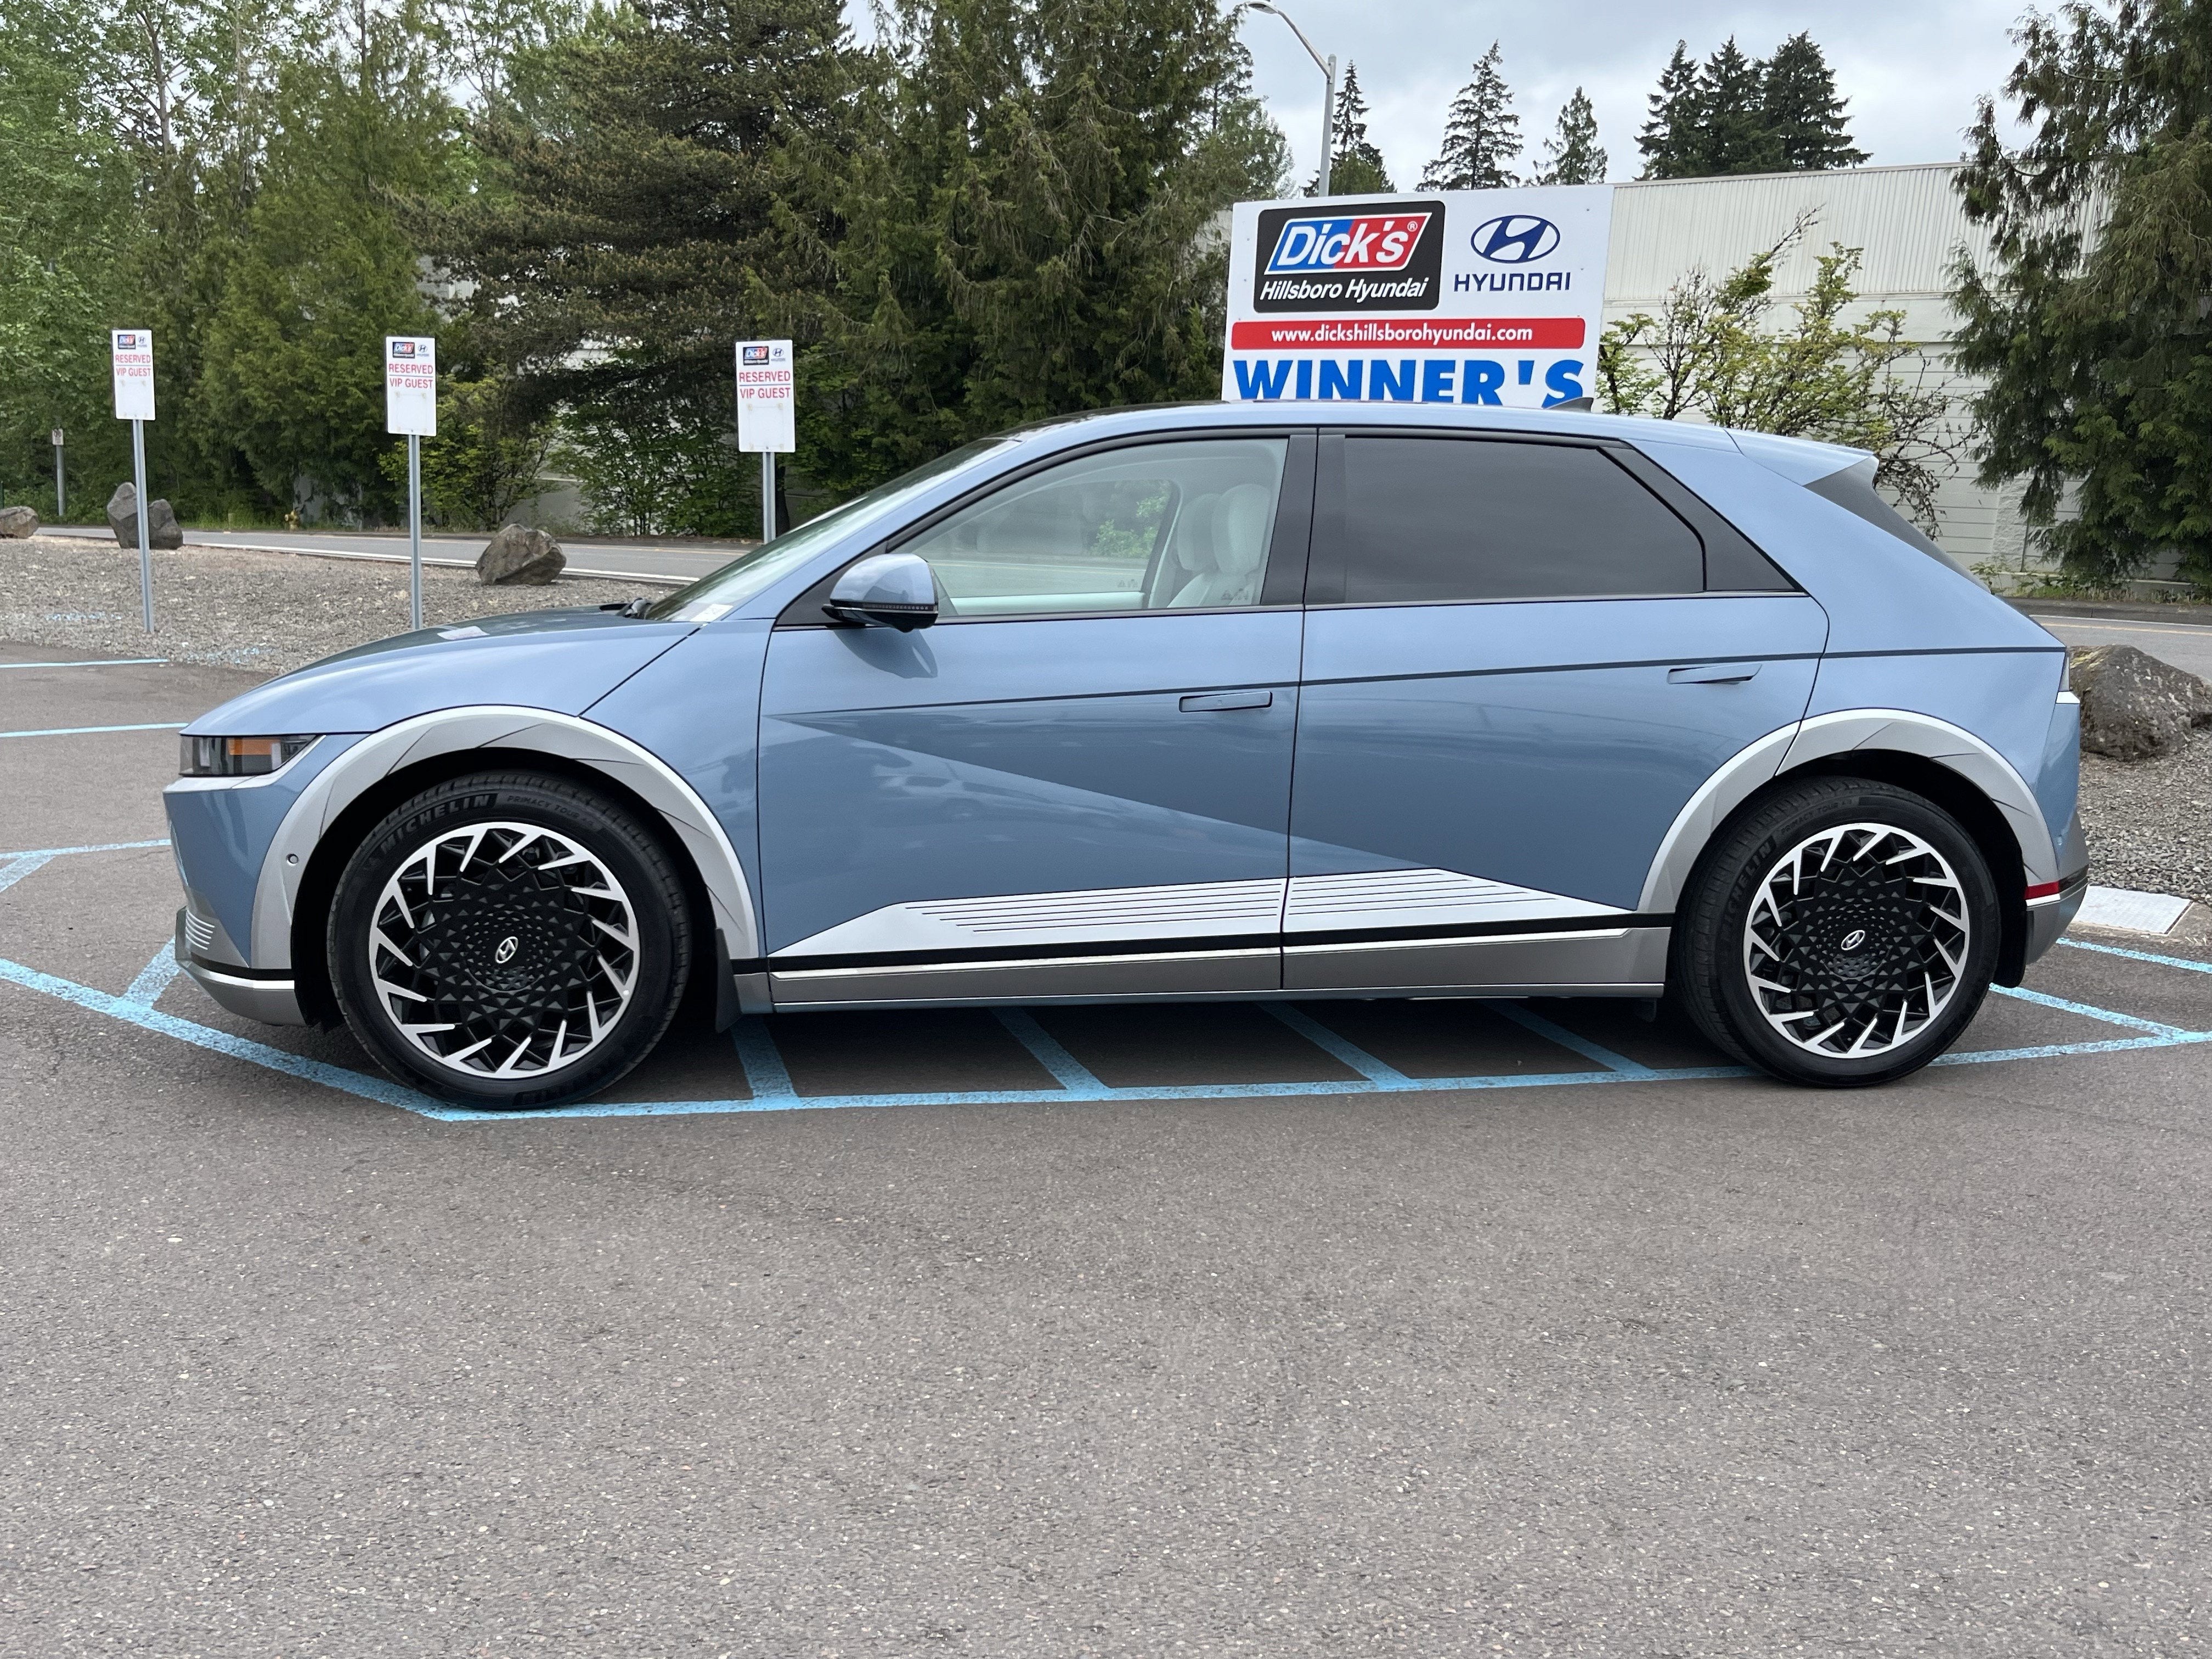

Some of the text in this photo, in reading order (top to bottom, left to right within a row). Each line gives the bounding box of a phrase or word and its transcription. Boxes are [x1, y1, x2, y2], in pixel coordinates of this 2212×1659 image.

[1277, 221, 1409, 266] Dick's
[1260, 277, 1429, 303] Hillsboro Hyundai
[1454, 272, 1571, 292] HYUNDAI
[1271, 322, 1533, 346] www.dickshillsborohyundai.com
[115, 354, 151, 363] RESERVED
[116, 368, 151, 377] VIP GUEST
[388, 363, 433, 375] RESERVED
[739, 371, 791, 382] RESERVED
[390, 378, 433, 389] VIP GUEST
[1233, 359, 1584, 409] WINNER'S
[740, 387, 791, 399] VIP GUEST
[380, 795, 490, 855] MICHELIN
